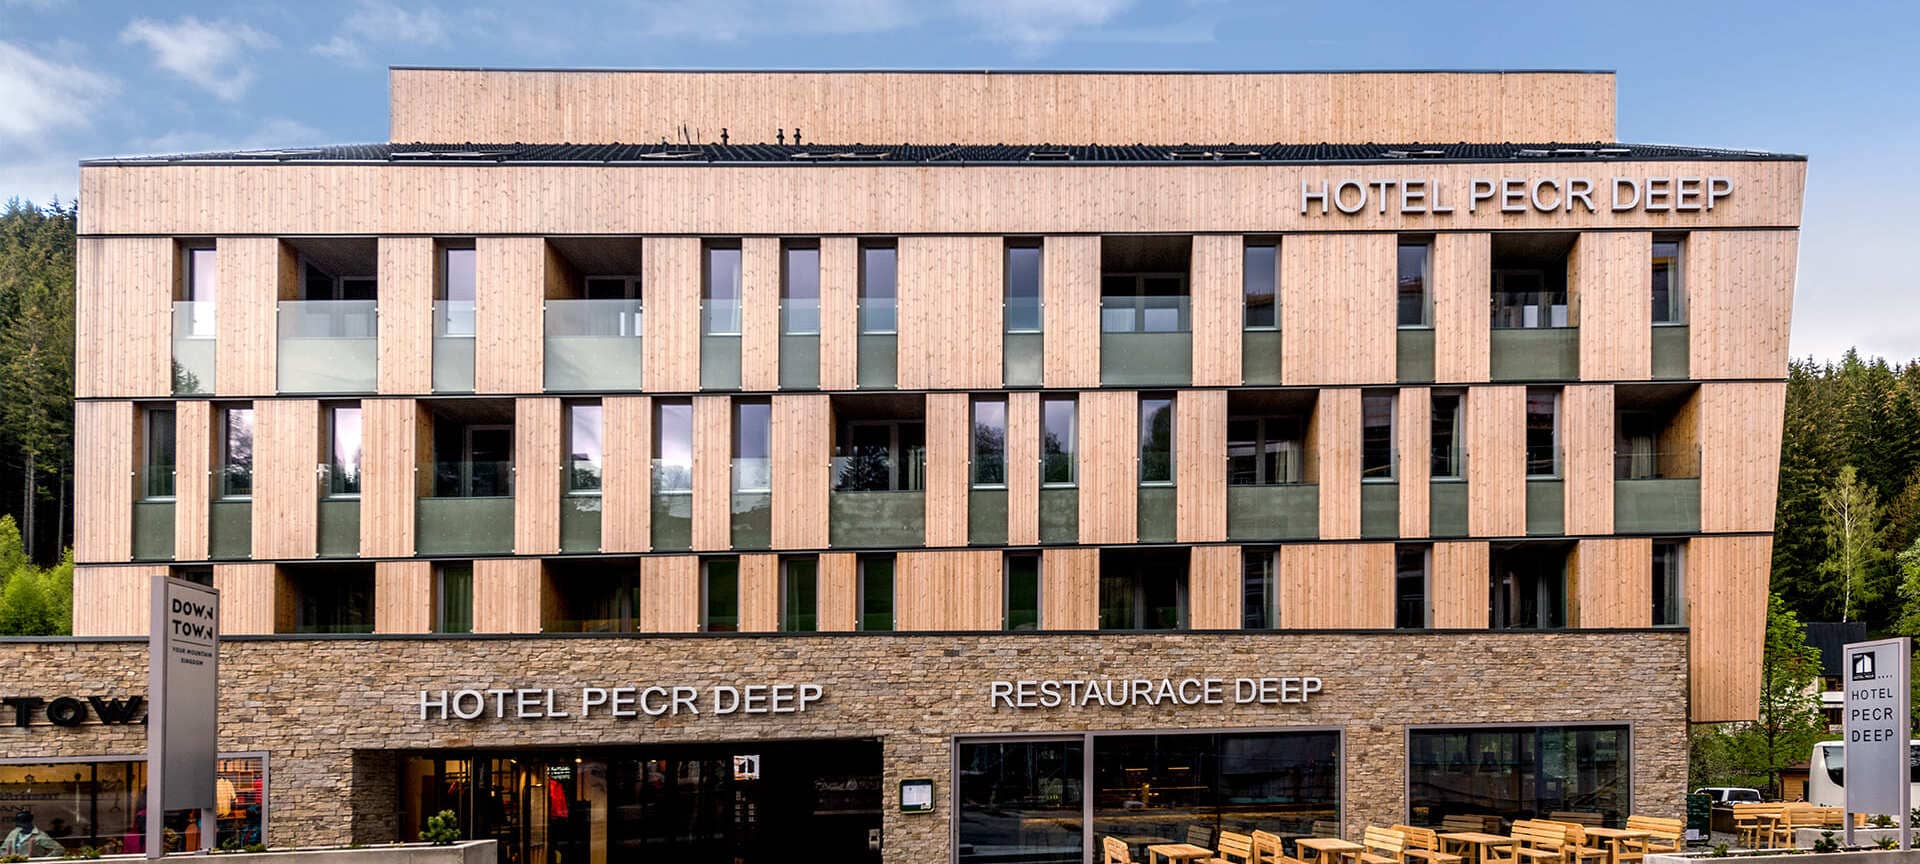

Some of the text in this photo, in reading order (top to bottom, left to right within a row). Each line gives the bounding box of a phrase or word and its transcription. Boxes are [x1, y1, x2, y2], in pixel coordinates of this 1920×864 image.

[1300, 175, 1735, 215] HOTEL PECR DEEP
[172, 598, 214, 620] DOWN
[172, 619, 213, 640] TOWN
[419, 685, 823, 720] HOTEL PECR DEEP
[991, 677, 1323, 708] RESTAURACE DEEP
[1851, 688, 1893, 700] HOTEL
[1851, 707, 1893, 720] PECR
[1851, 729, 1894, 742] DEEP
